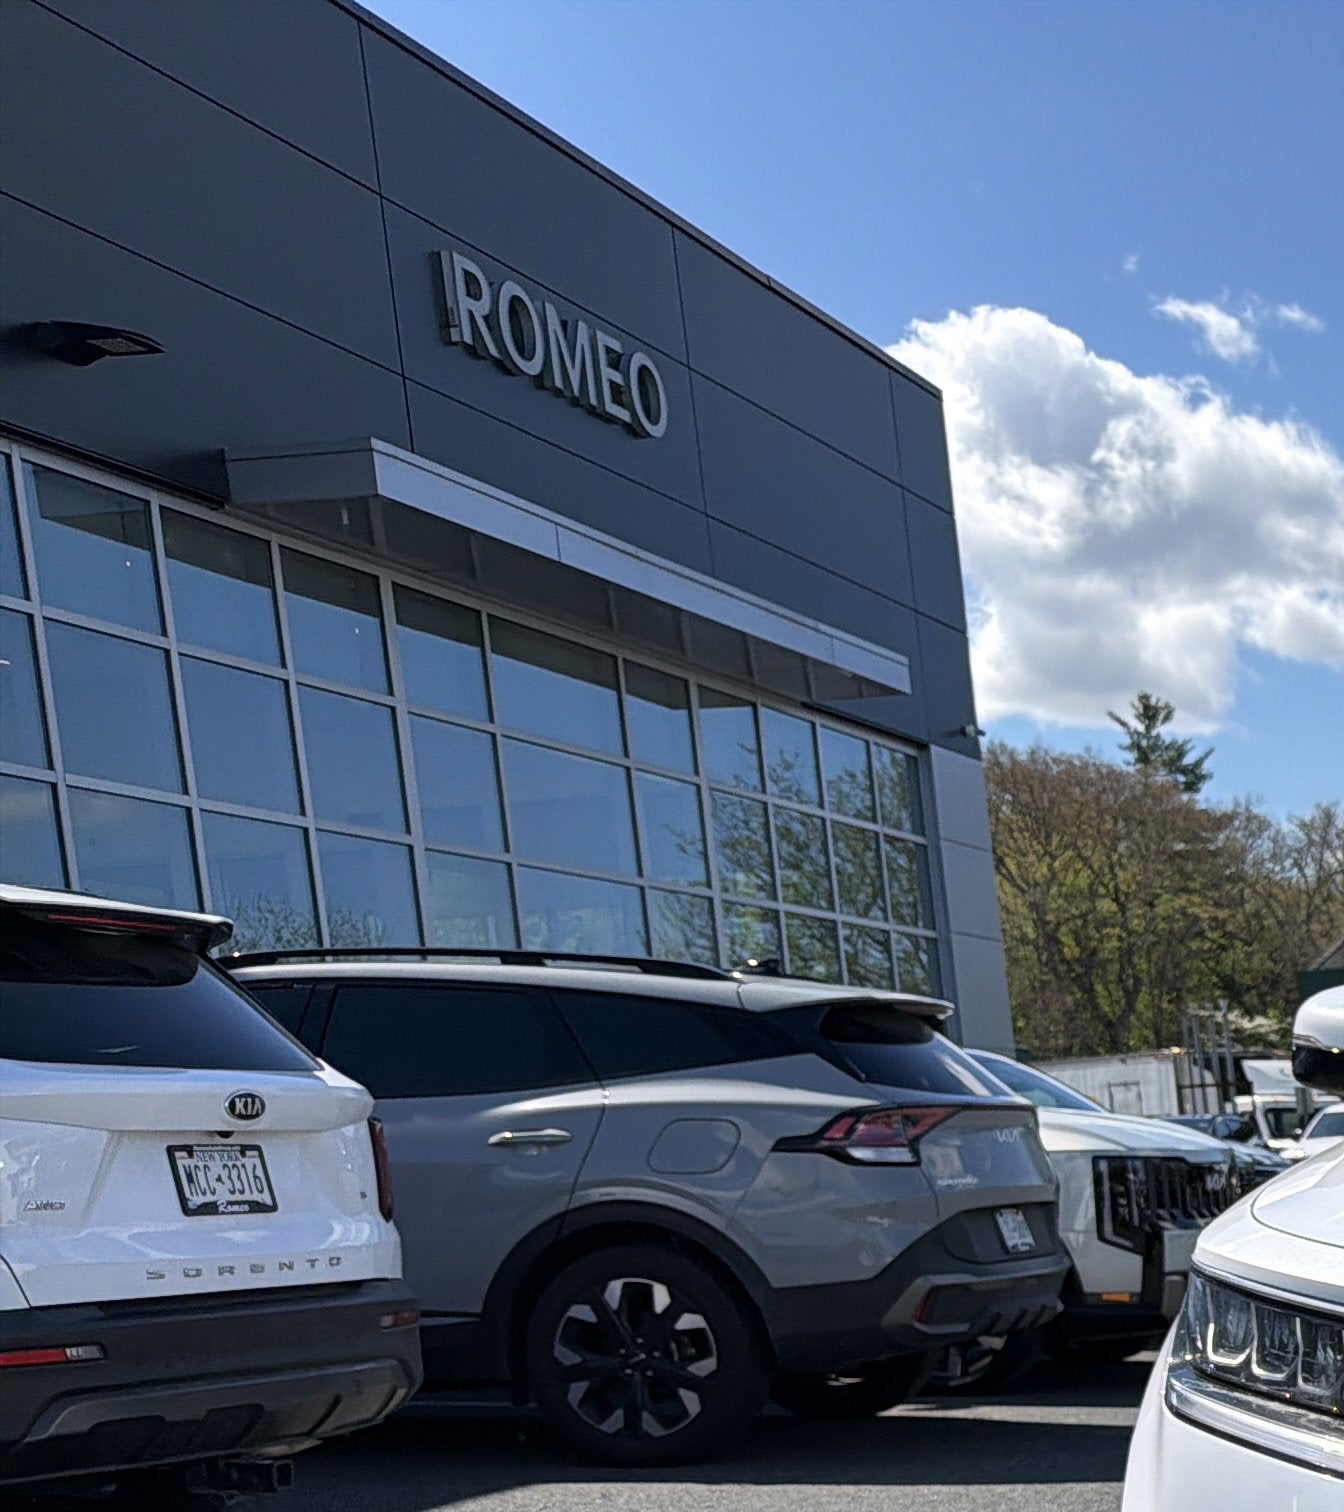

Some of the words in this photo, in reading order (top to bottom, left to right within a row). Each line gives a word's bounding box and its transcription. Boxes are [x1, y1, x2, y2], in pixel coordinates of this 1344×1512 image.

[442, 250, 668, 438] ROMEO
[234, 1097, 266, 1116] KIA
[195, 1151, 216, 1163] NEW
[217, 1150, 242, 1162] YORK
[181, 1163, 217, 1198] MCC
[221, 1162, 265, 1196] 3316
[146, 1256, 342, 1280] SORENTO
